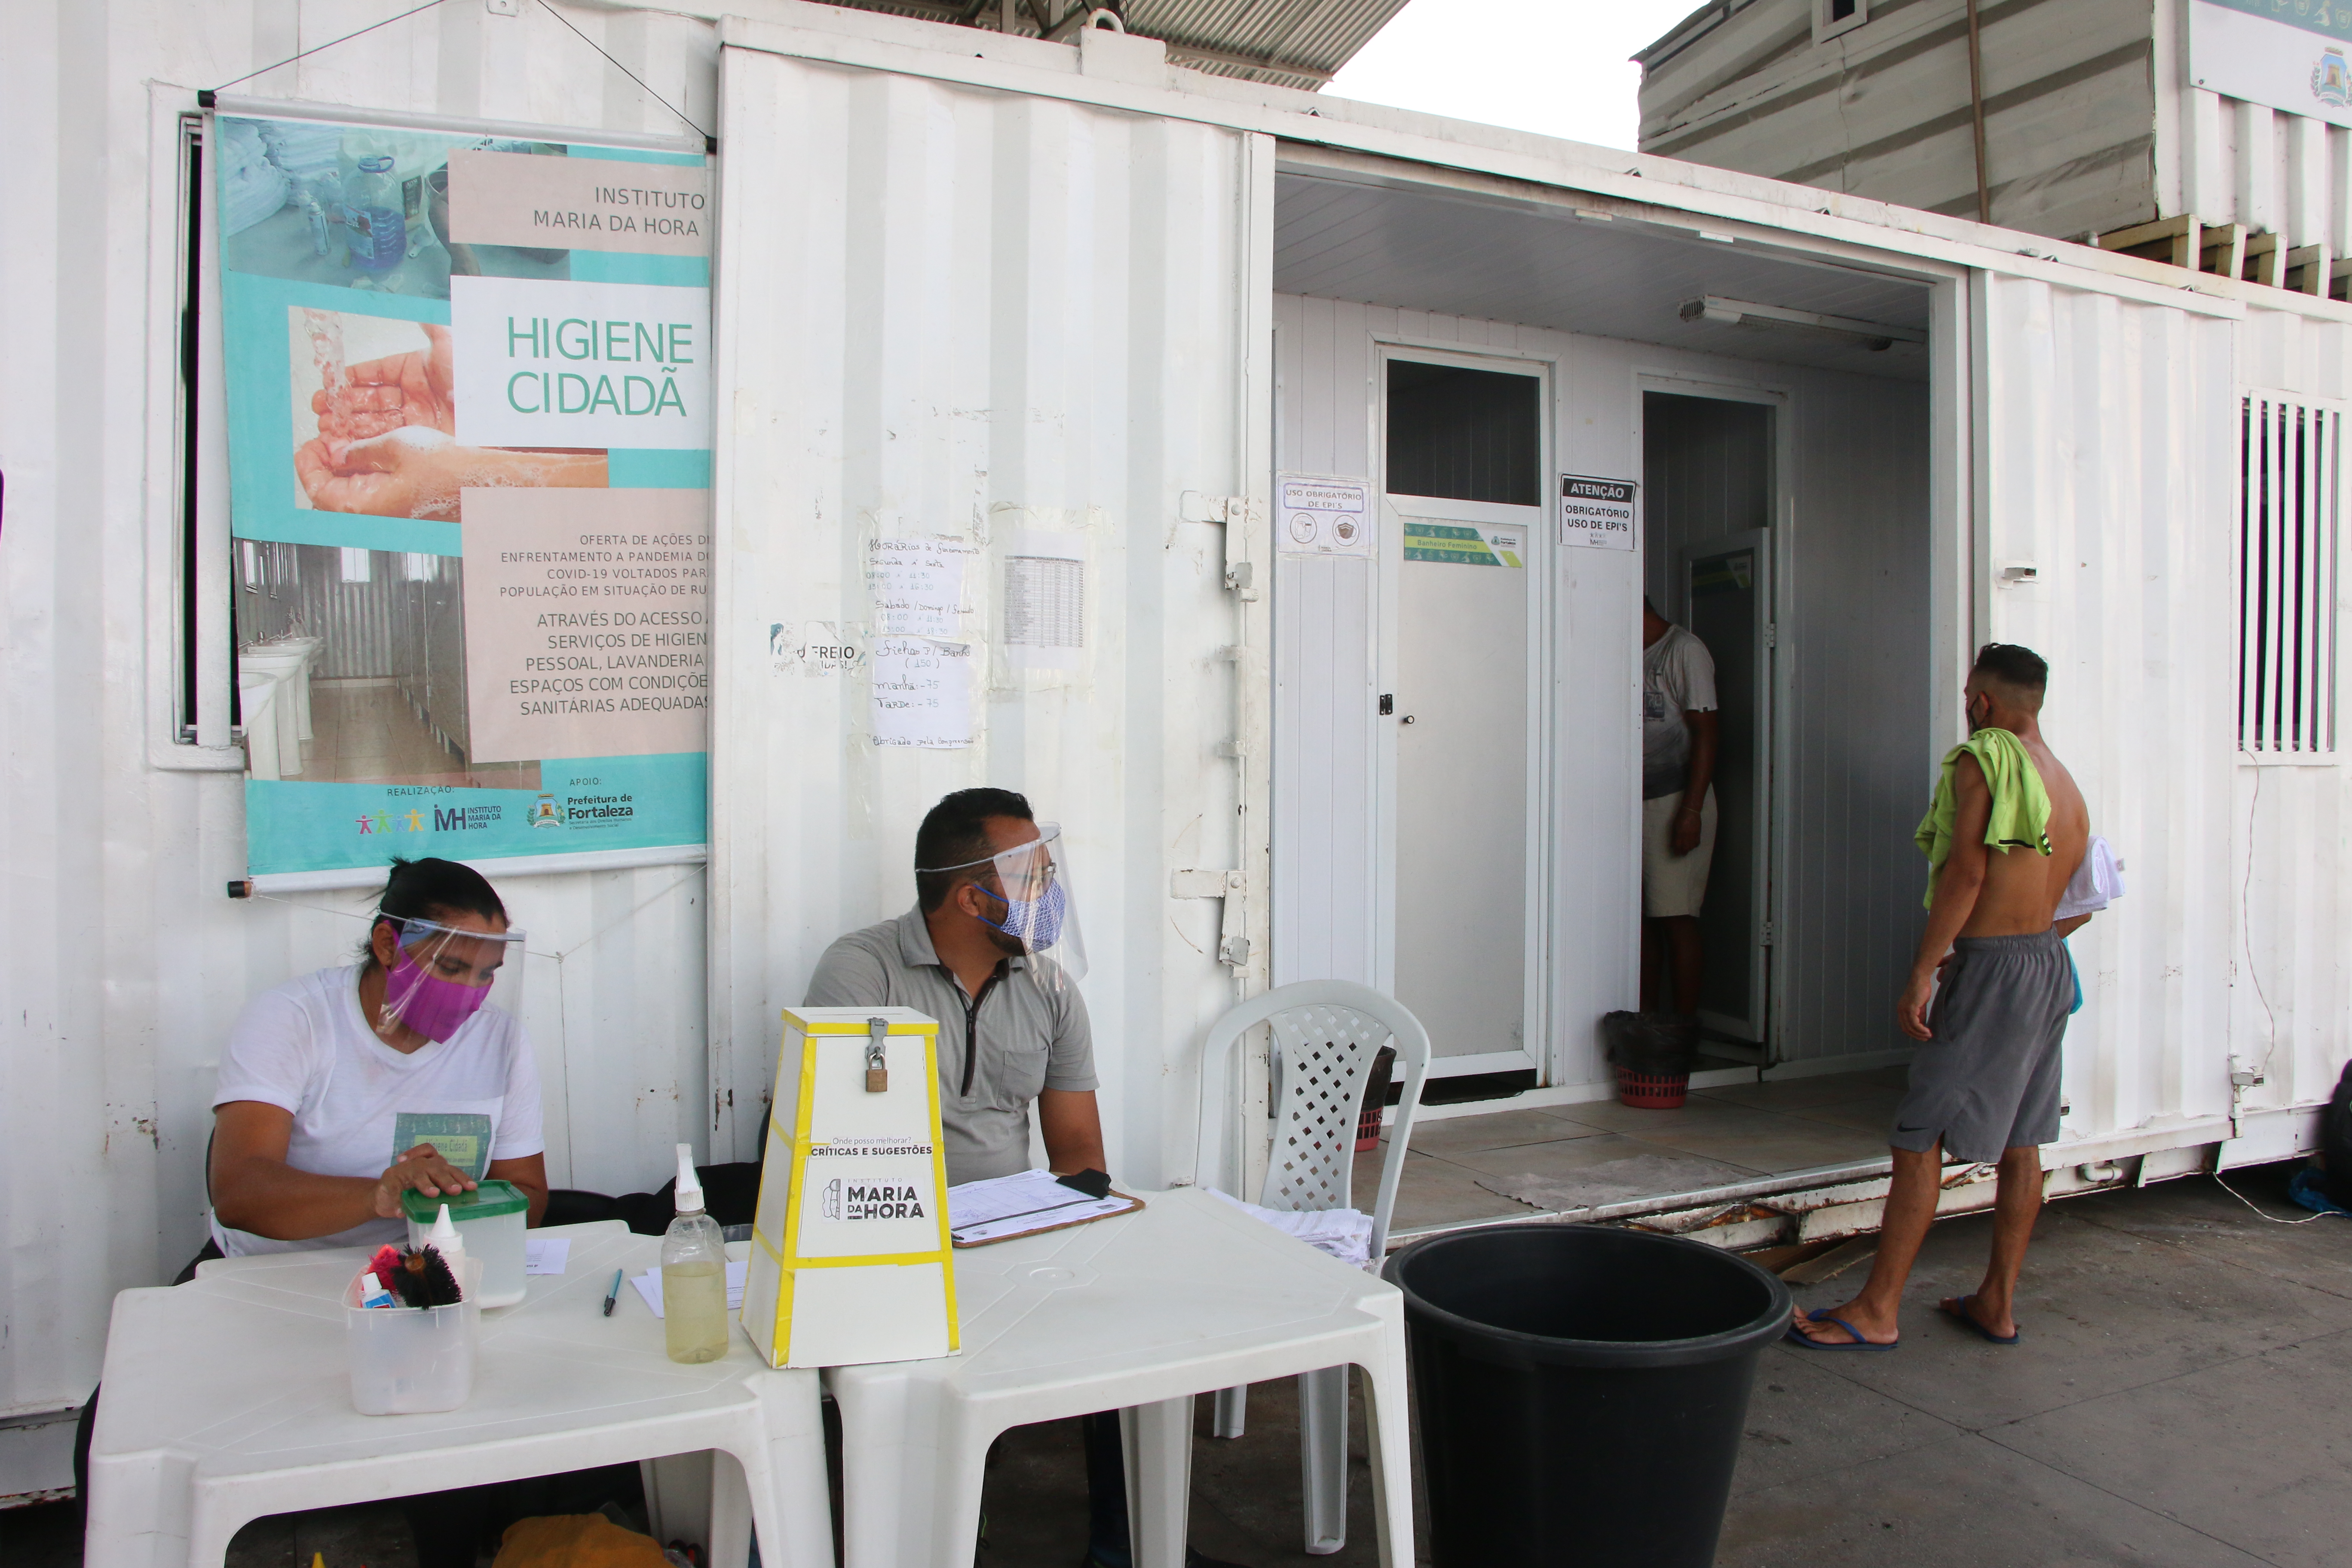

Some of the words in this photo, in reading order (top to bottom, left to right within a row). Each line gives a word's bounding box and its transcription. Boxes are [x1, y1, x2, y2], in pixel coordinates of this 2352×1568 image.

[595, 187, 704, 210] INSTITUTO
[534, 210, 602, 230] MARIA
[609, 215, 637, 232] DA
[644, 217, 699, 236] HORA
[508, 316, 694, 364] HIGIENE
[507, 366, 687, 416] CIDADÃ
[1306, 492, 1362, 500] OBRIGATÓRIO
[1571, 483, 1624, 499] ATENÇÃO
[1565, 505, 1629, 518] OBRIGATÓRIO
[1568, 518, 1587, 528] USO
[1591, 521, 1603, 529] DE
[1606, 522, 1627, 531] EPI'S
[580, 535, 627, 545] OFERTA
[632, 535, 648, 545] DE
[652, 533, 692, 547] AÇÕES
[698, 535, 709, 545] D
[501, 552, 612, 562] ENFRENTAMENTO
[616, 552, 624, 562] A
[628, 552, 692, 561] PANDEMIA
[698, 552, 709, 561] D
[547, 569, 607, 579] COVID-19
[613, 568, 677, 579] VOLTADOS
[683, 569, 708, 578] PAR
[500, 583, 577, 598] POPULAÇÃO
[582, 586, 599, 596] EM
[604, 583, 666, 597] SITUAÇÃO
[671, 585, 686, 595] DE
[691, 585, 706, 594] RU
[537, 611, 608, 627] ATRAVÉS
[615, 613, 636, 626] DO
[640, 612, 702, 626] ACESSO
[548, 634, 625, 650] SERVIÇOS
[631, 634, 650, 647] DE
[655, 633, 706, 646] HIGIEN
[527, 656, 602, 671] PESSOAL,
[607, 654, 704, 669] LAVANDERIA
[510, 678, 583, 695] ESPAÇOS
[589, 677, 623, 690] COM
[629, 671, 707, 692] CONDIÇÕE
[521, 697, 615, 715] SANITÁRIAS
[568, 796, 617, 805] Prefeitura
[620, 794, 632, 802] de
[568, 805, 633, 819] Fortaleza
[812, 1146, 858, 1156] CRÍTICAS
[872, 1145, 932, 1155] SUGESTÕES
[848, 1186, 918, 1202] MARIA
[848, 1204, 863, 1213] DA
[864, 1203, 924, 1219] HORA
